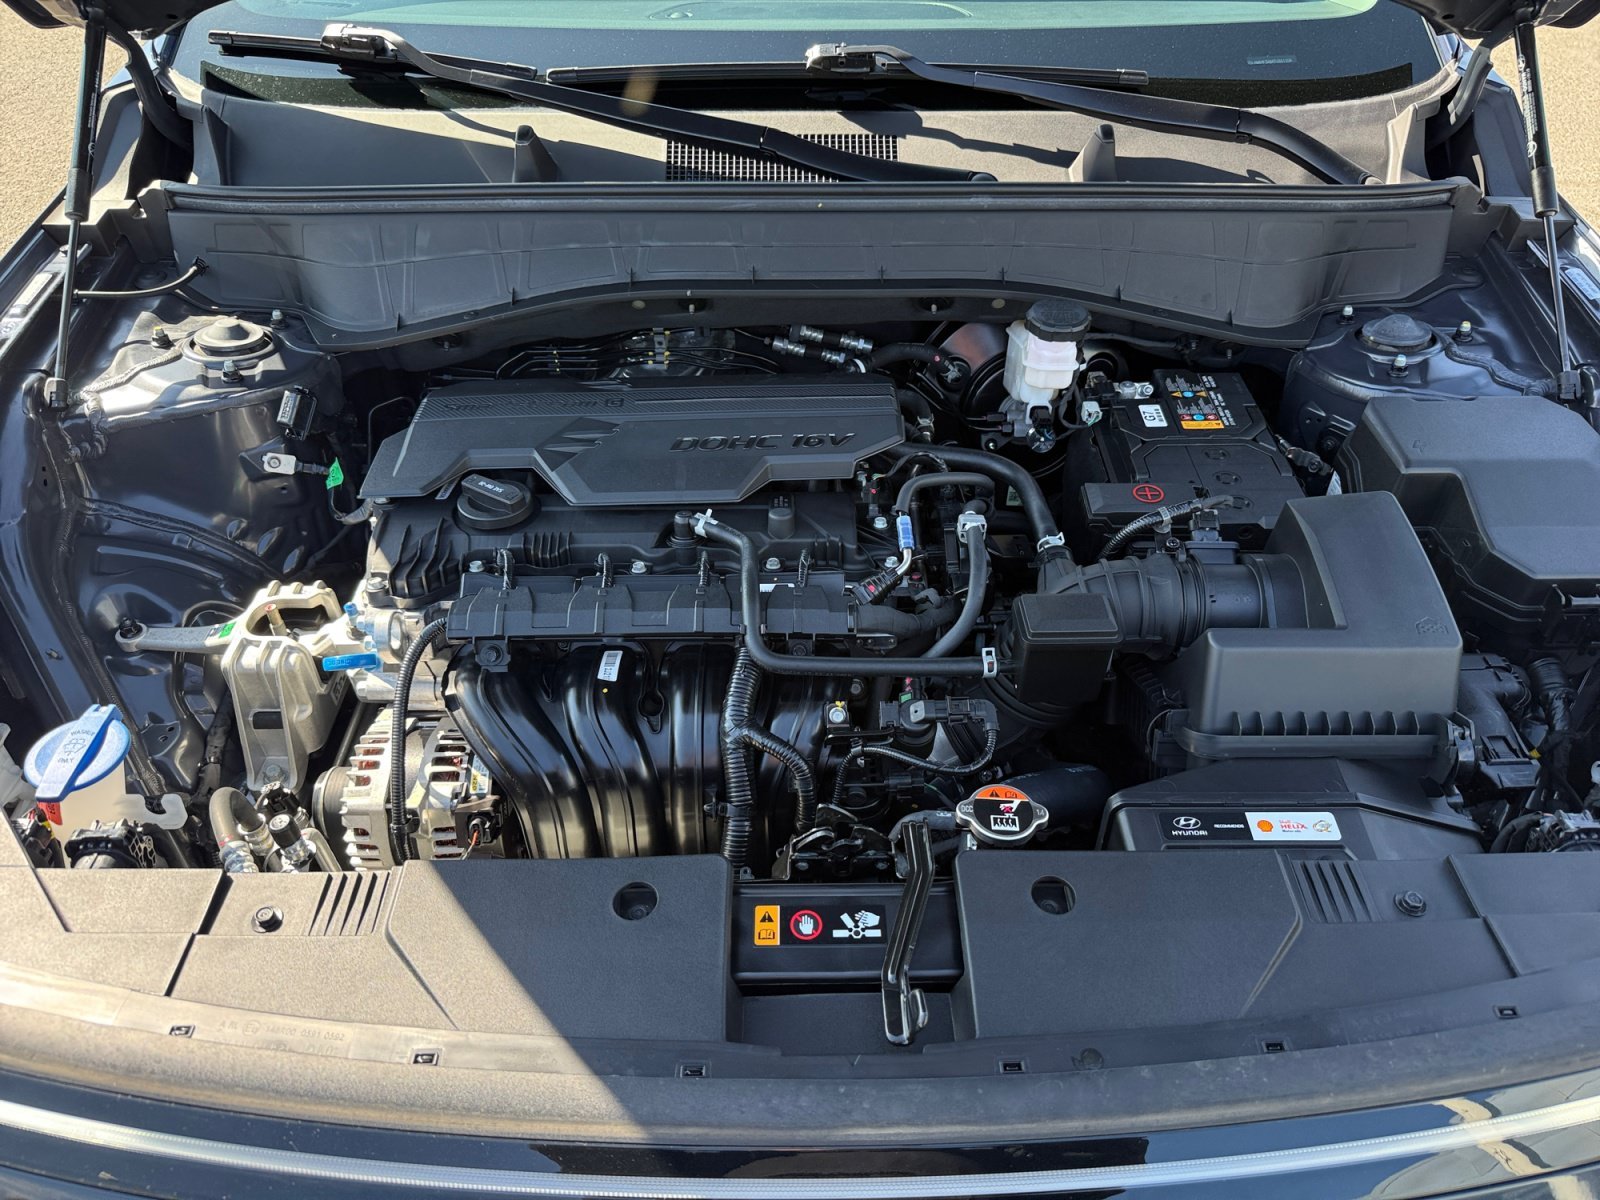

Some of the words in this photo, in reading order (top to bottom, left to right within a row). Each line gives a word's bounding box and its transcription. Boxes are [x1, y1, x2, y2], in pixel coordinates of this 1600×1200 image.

[607, 397, 622, 408] G
[1144, 410, 1156, 422] G7
[671, 434, 783, 451] DOHC
[791, 432, 856, 449] 16V
